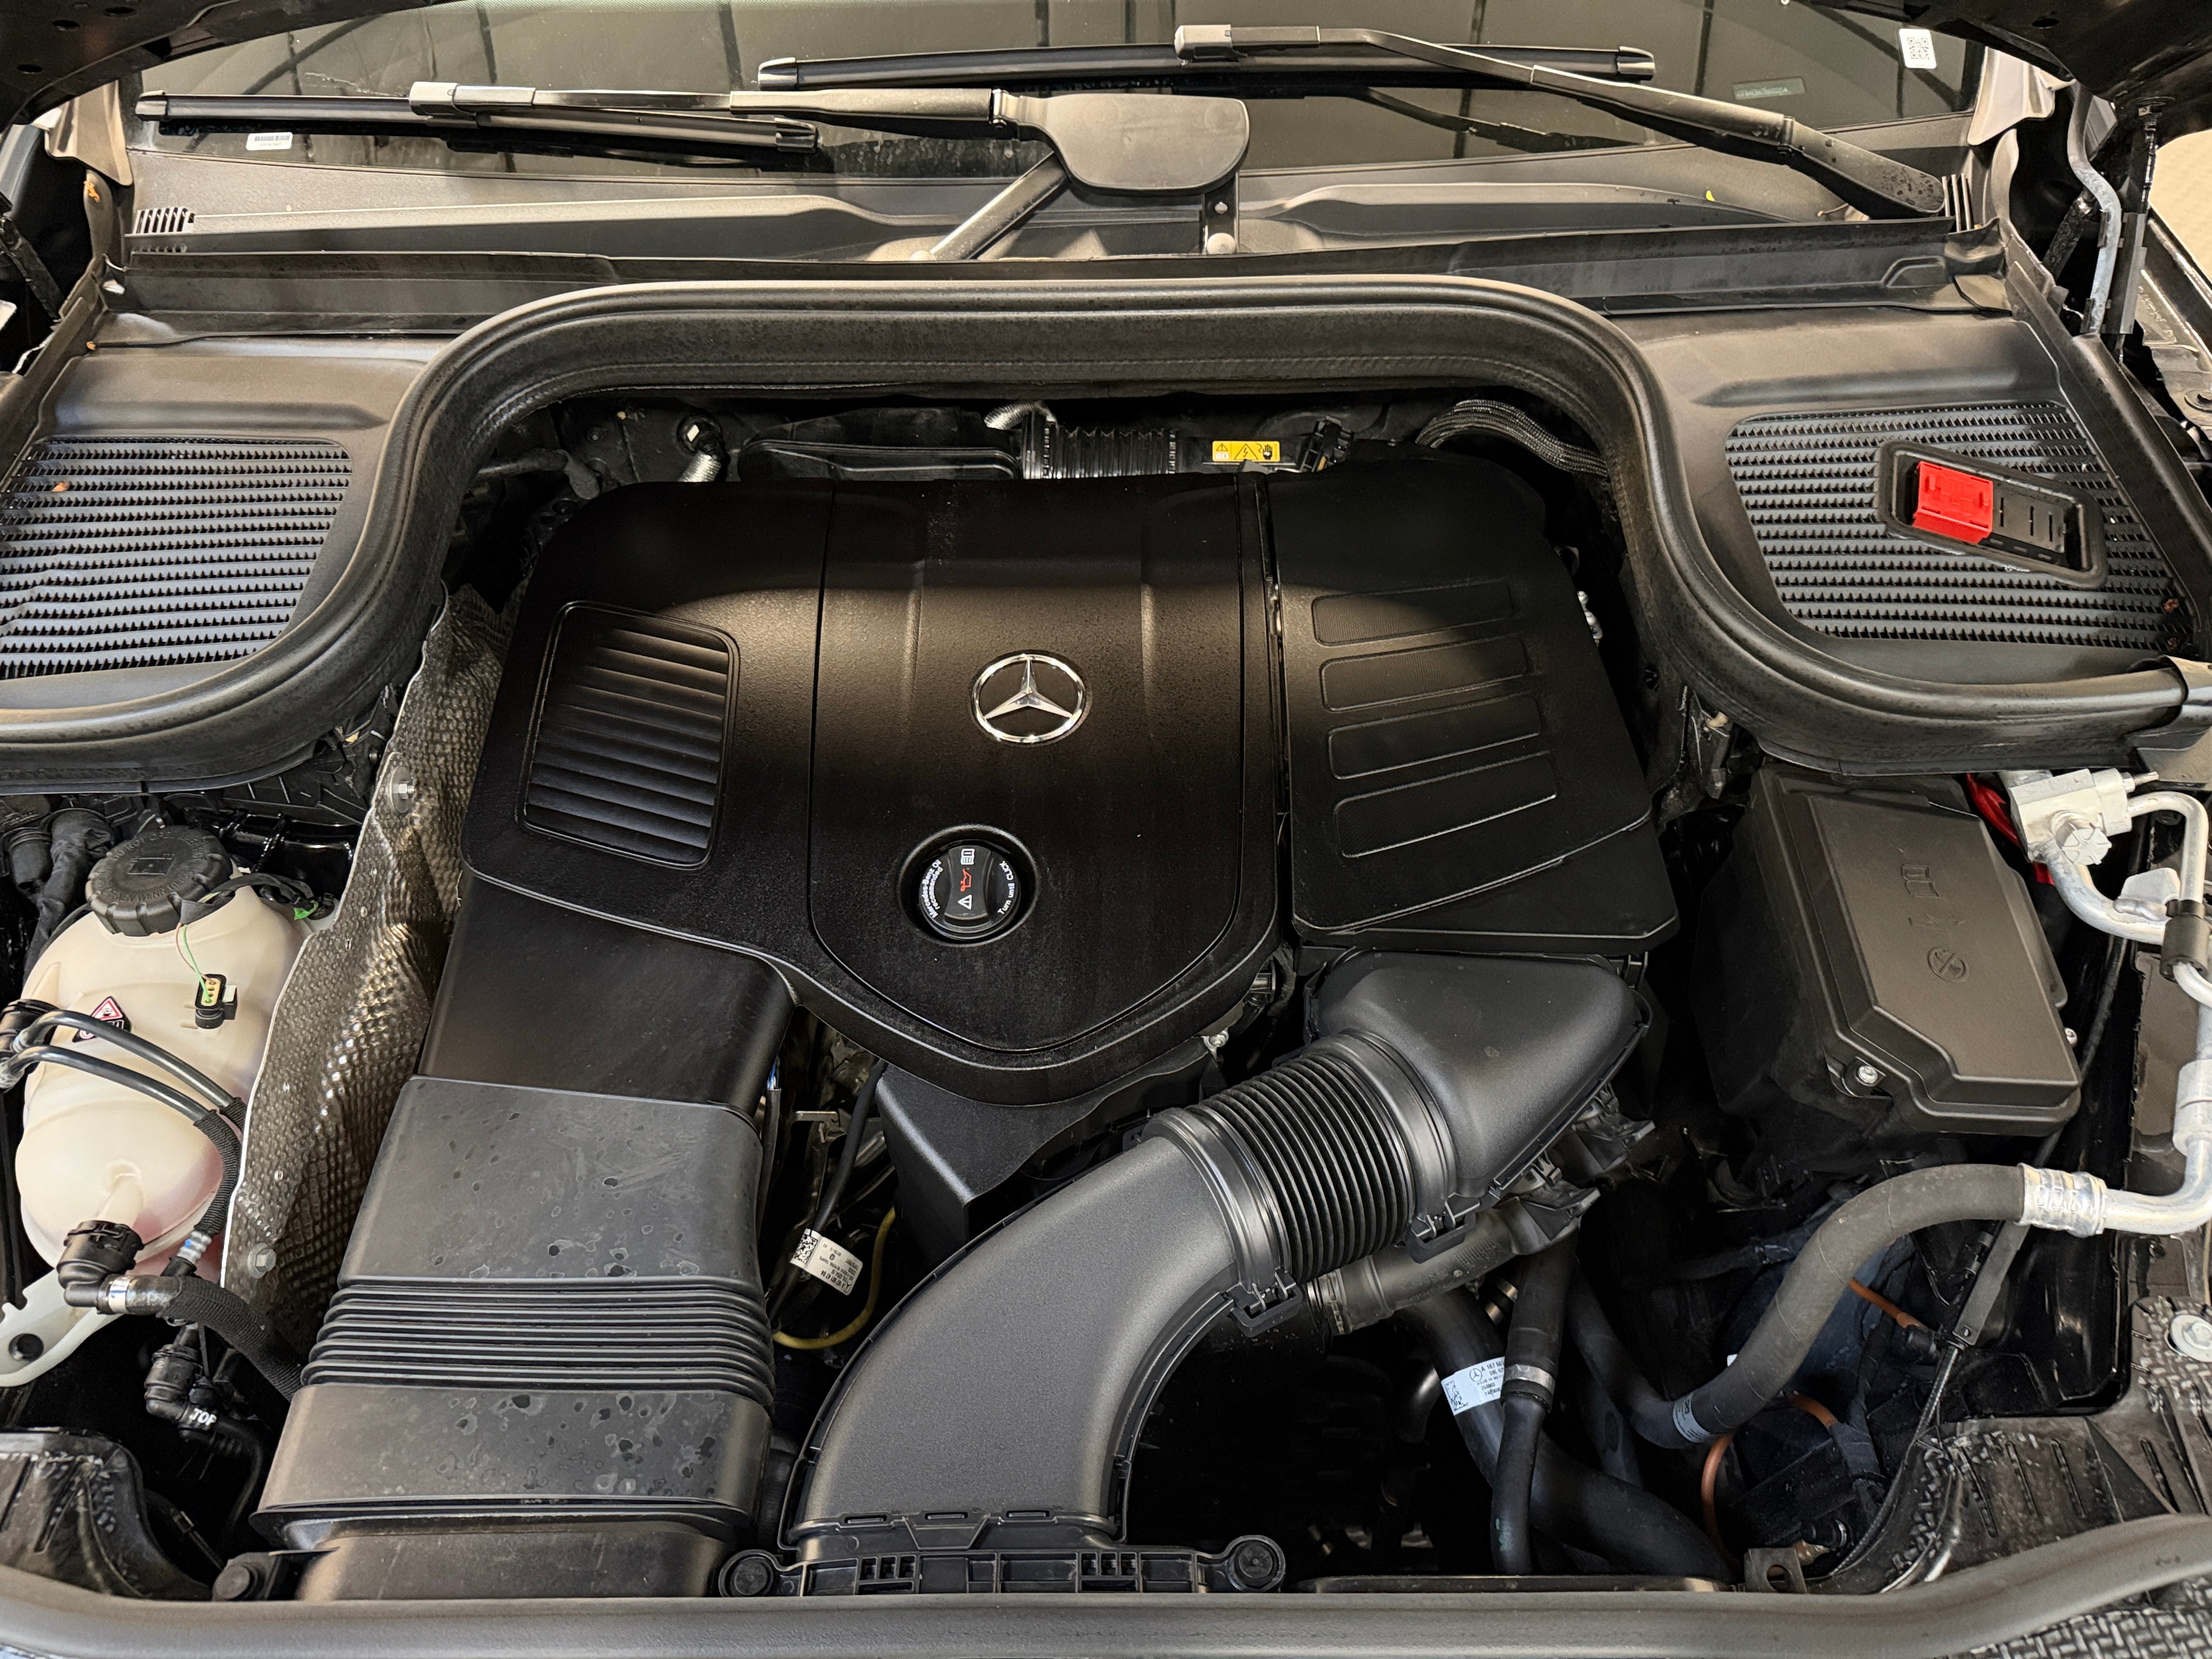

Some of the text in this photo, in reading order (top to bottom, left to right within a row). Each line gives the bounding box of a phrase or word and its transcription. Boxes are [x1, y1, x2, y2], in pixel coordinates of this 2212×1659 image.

[998, 860, 1014, 881] CLICK
[921, 867, 939, 918] Mercedes-Benz
[929, 866, 944, 910] recommended
[997, 900, 1012, 915] Turn
[193, 1407, 217, 1426] TOP
